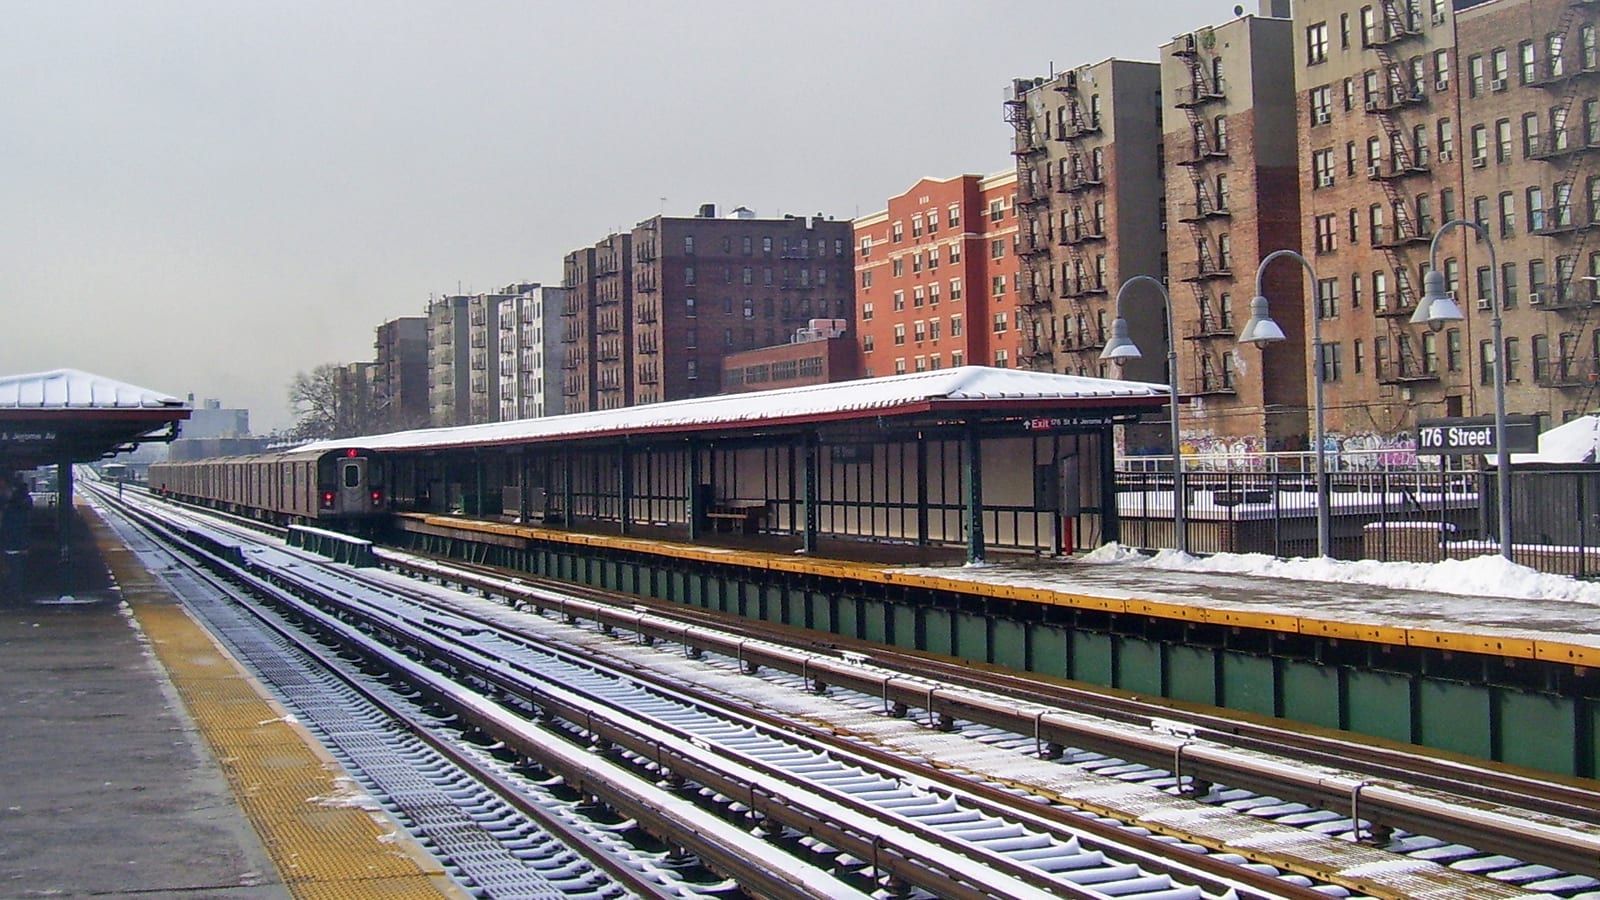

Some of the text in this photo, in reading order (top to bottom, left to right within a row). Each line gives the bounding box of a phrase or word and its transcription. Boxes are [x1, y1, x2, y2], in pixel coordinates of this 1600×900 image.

[1031, 419, 1050, 429] Exit
[1420, 427, 1491, 446] 176 Street
